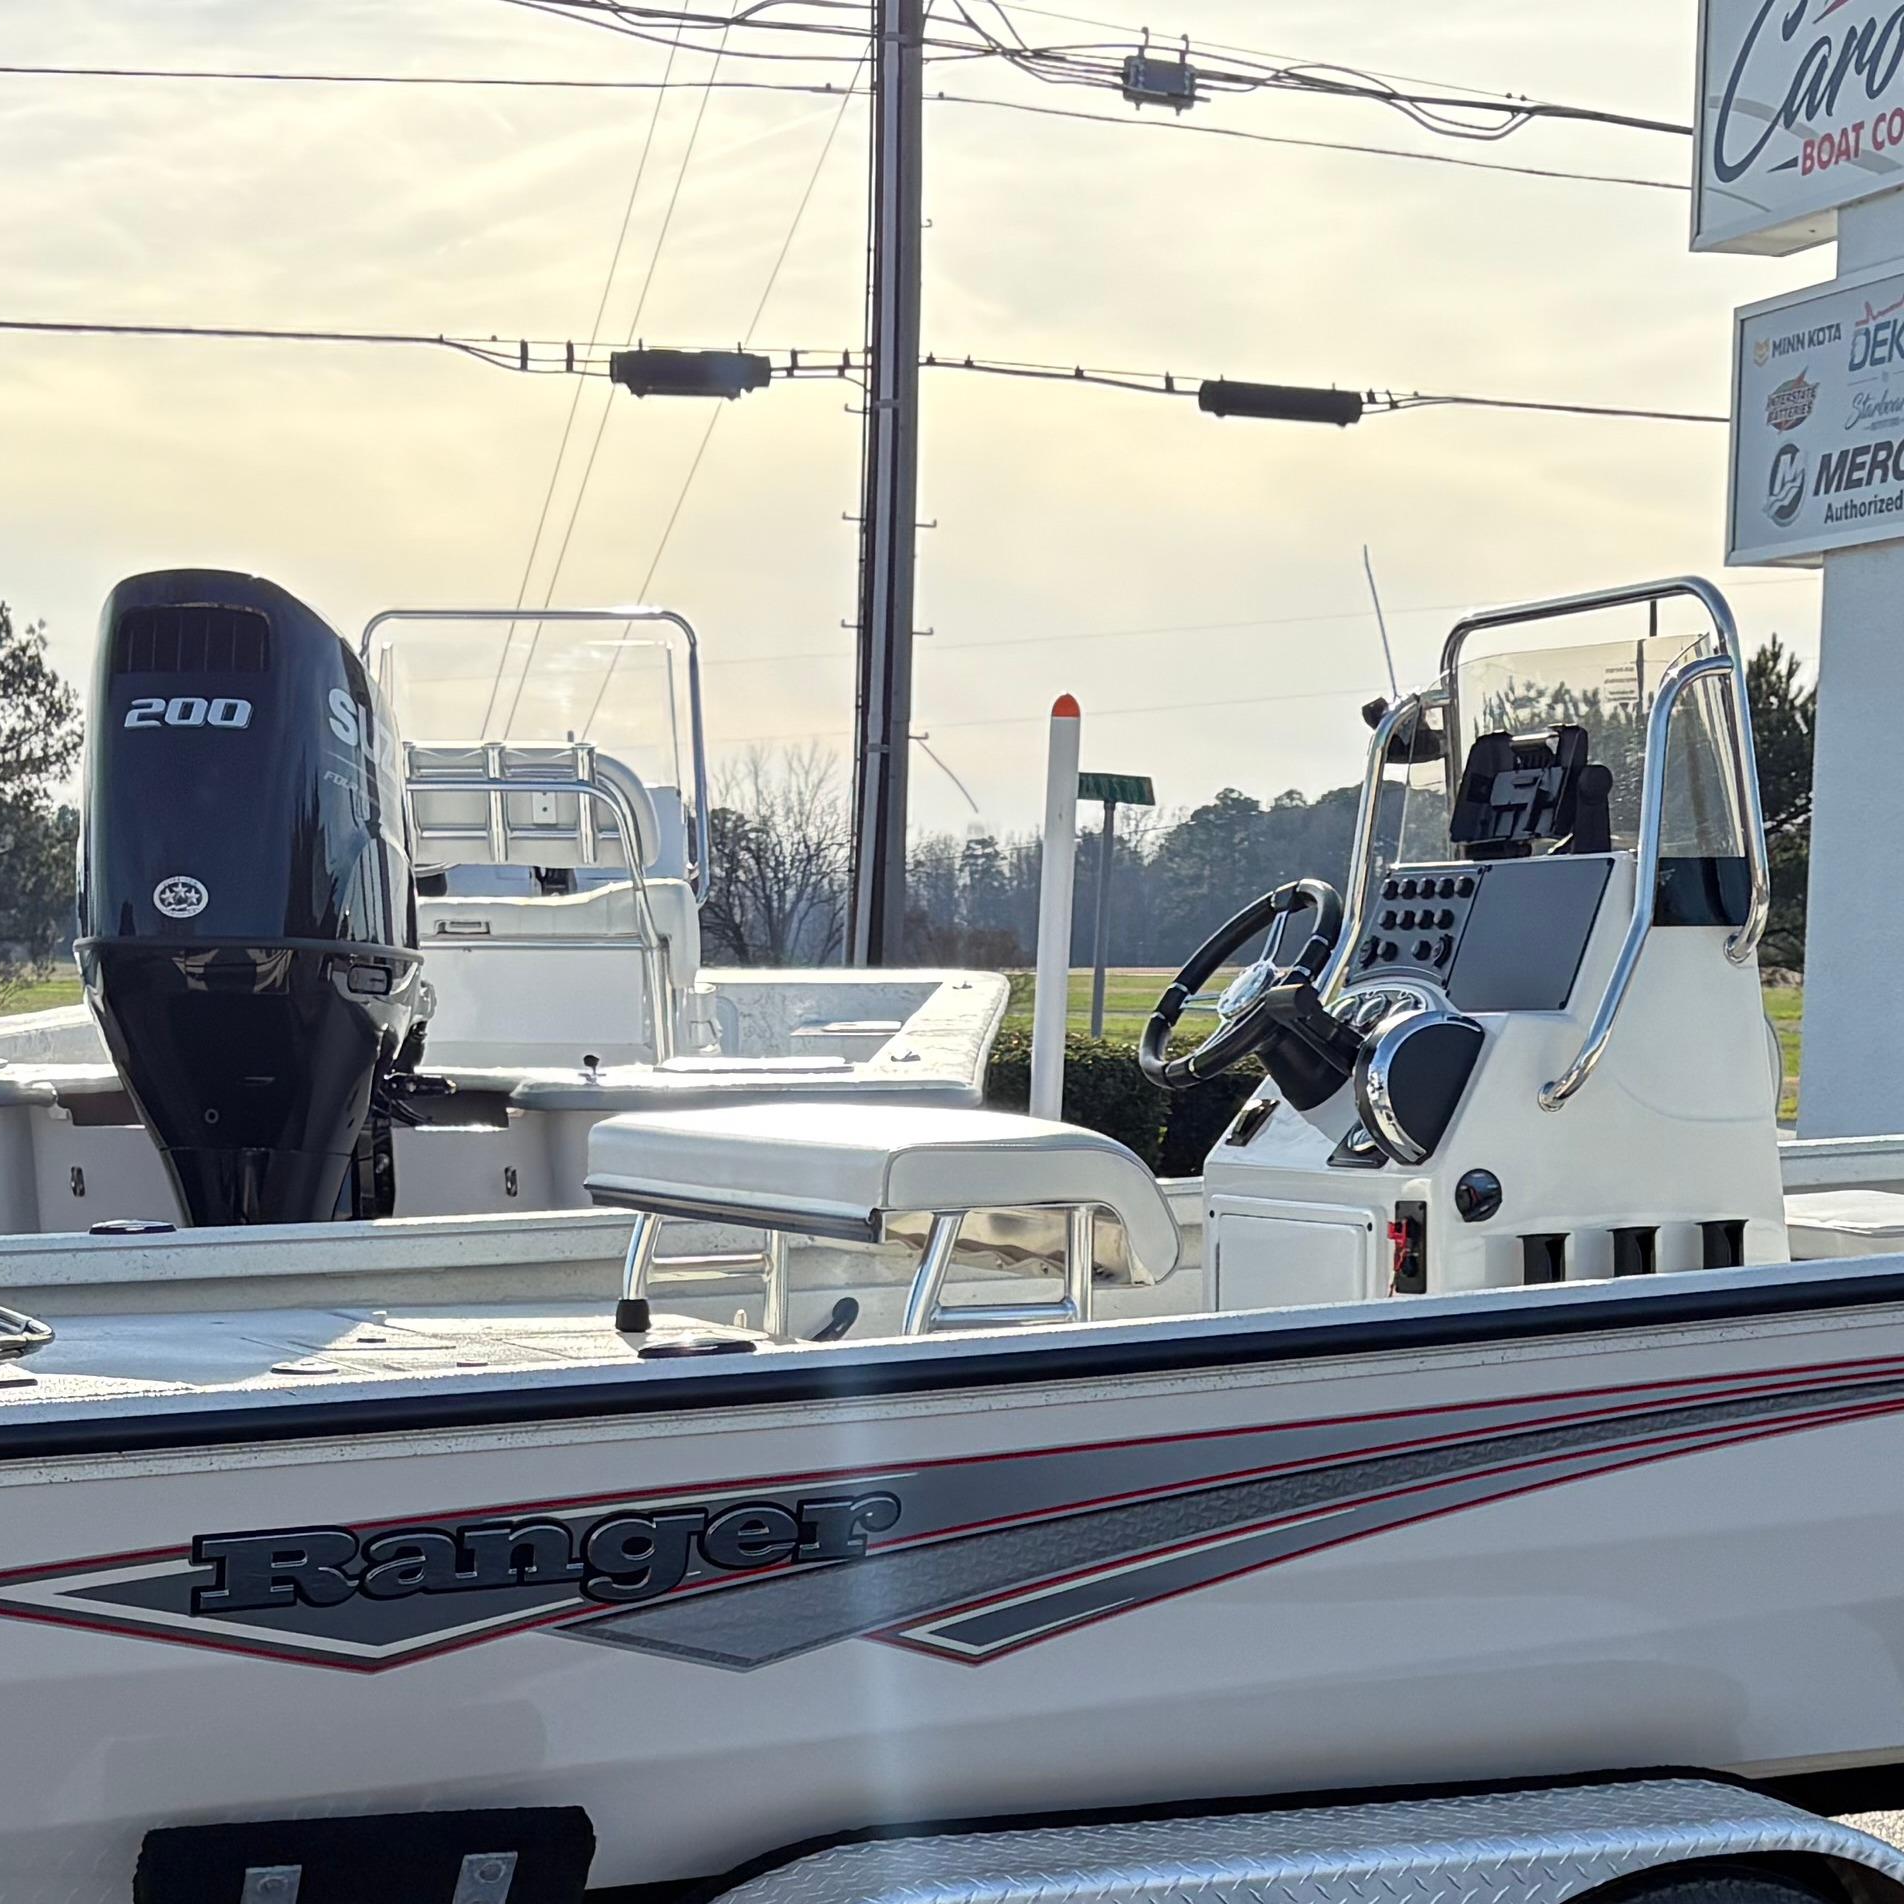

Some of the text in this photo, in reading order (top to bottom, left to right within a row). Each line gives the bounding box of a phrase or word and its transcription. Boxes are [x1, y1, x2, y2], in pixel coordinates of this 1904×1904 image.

[1802, 121, 1865, 176] BOAT
[1772, 323, 1841, 358] MINN KOTA
[1824, 489, 1903, 524] Authorized
[124, 697, 252, 729] 200
[191, 1492, 901, 1616] Ranger
